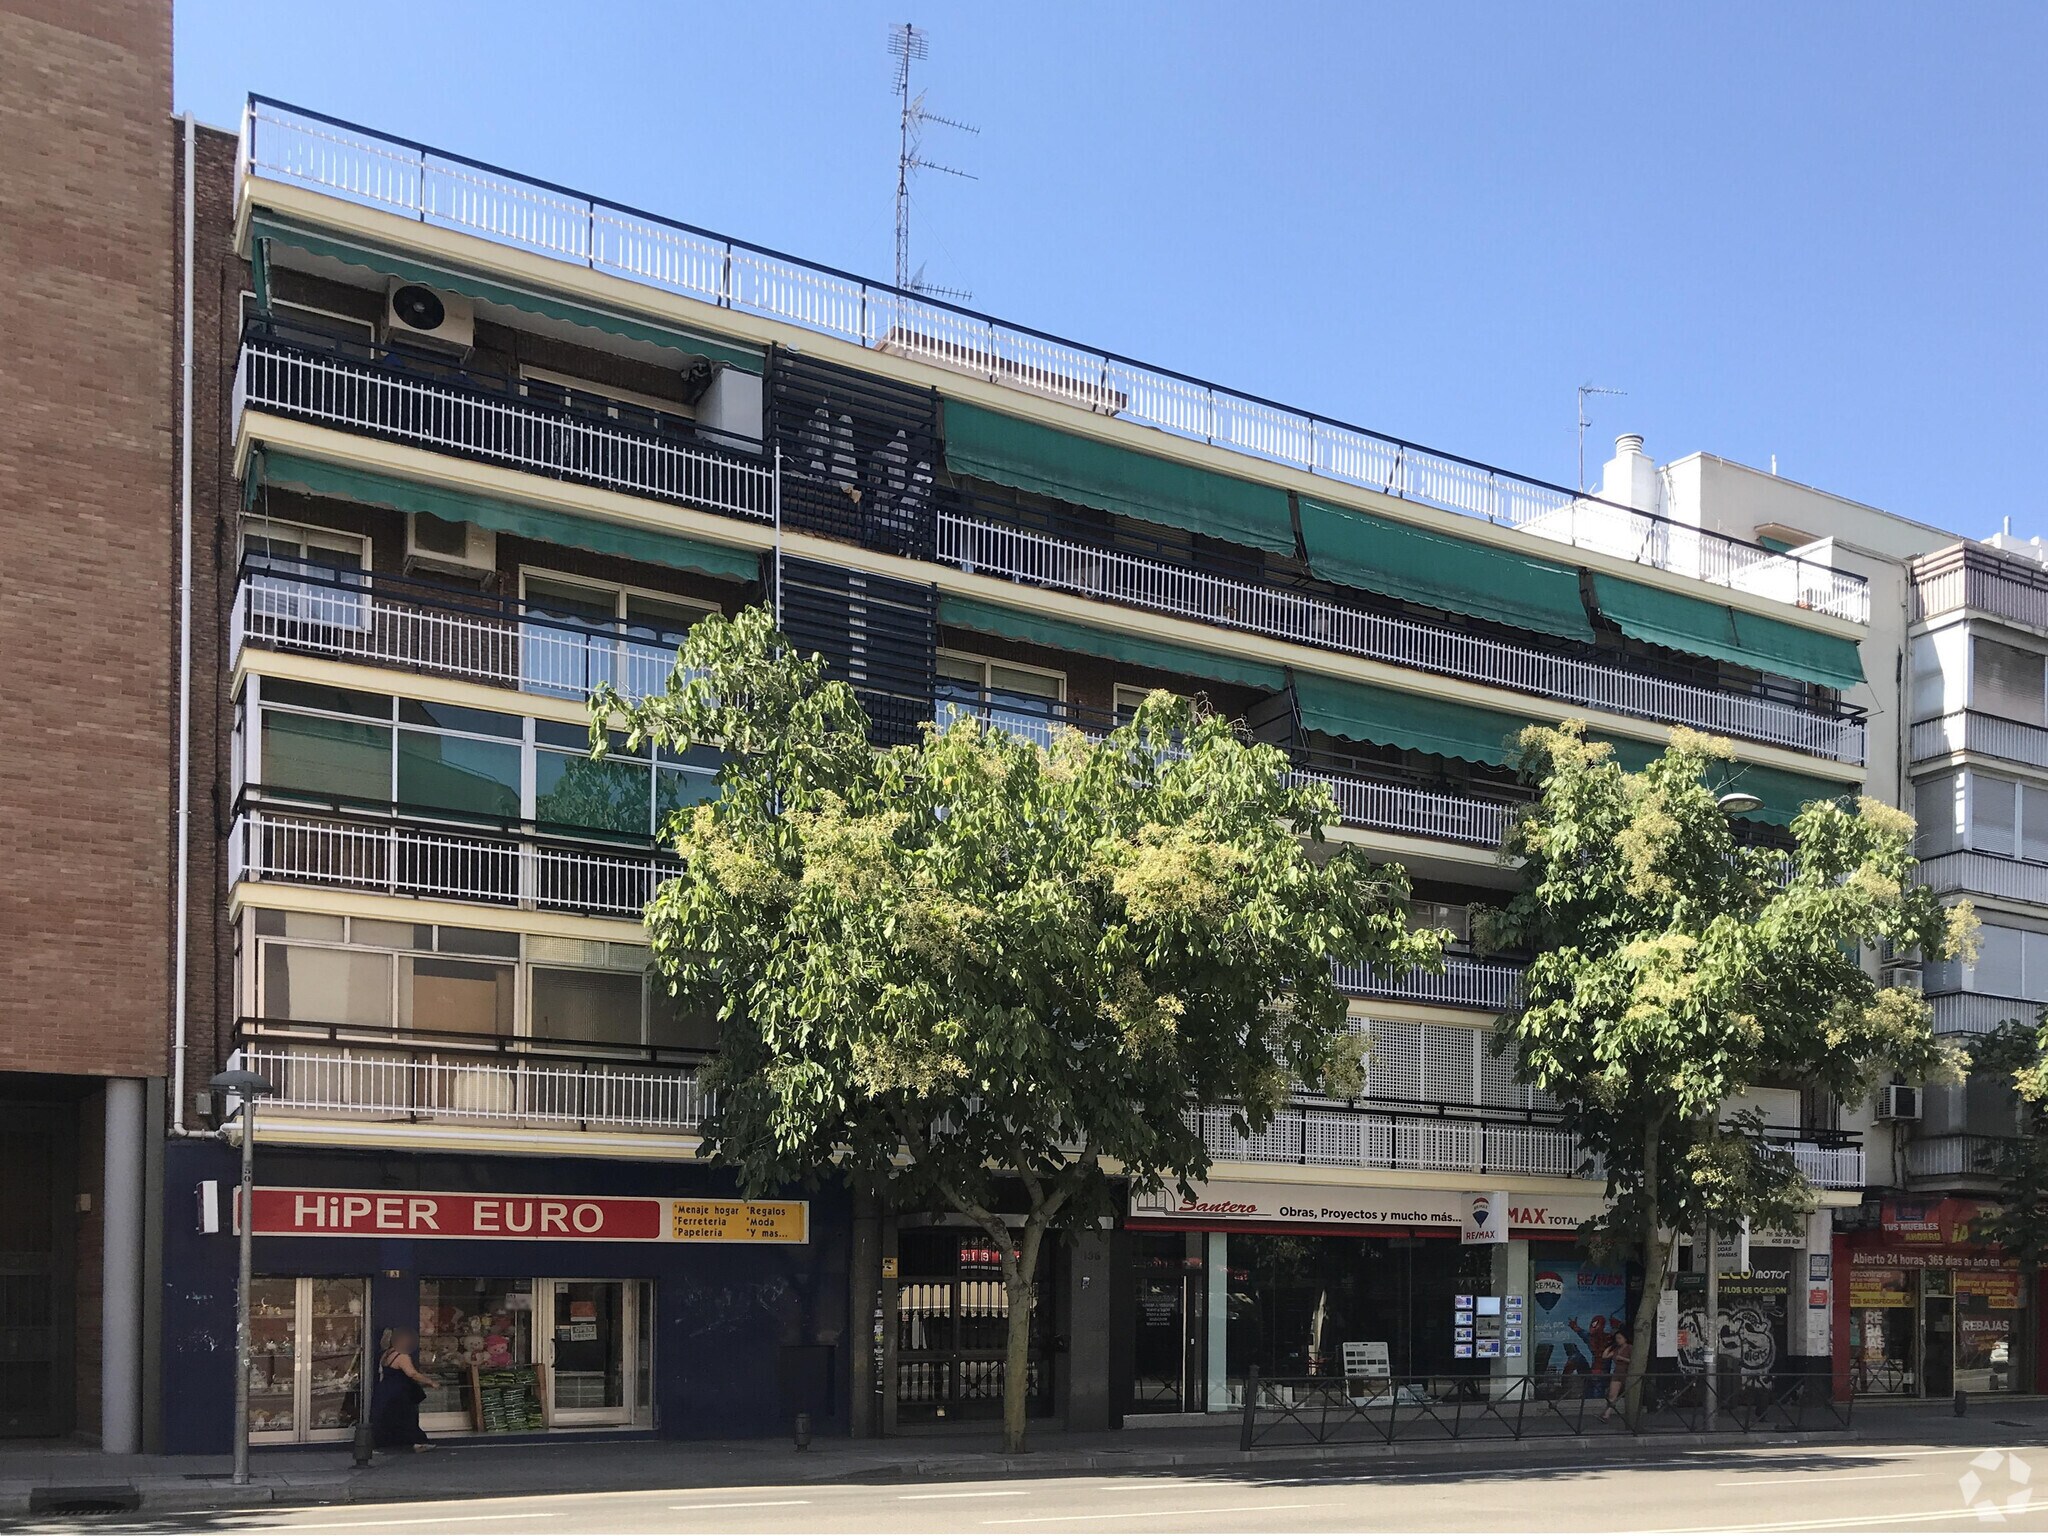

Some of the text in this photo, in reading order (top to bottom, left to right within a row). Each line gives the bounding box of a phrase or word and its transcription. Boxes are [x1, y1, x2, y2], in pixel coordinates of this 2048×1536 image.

[714, 1206, 739, 1216] hogar
[1178, 1196, 1258, 1213] Santero
[294, 1195, 604, 1233] HiPER EURO
[1279, 1206, 1462, 1222] Obras, Proyectos y mucho más...
[1508, 1207, 1580, 1226] MAX TOTAL
[749, 1217, 775, 1227] Moda
[1883, 1222, 1939, 1231] TUS MUEBLES
[1466, 1230, 1496, 1240] RE/MAX
[1852, 1253, 1885, 1265] Abierto
[1887, 1254, 1898, 1265] 24
[1899, 1254, 1927, 1267] horas,
[1928, 1255, 1943, 1265] 365
[1990, 1258, 2000, 1267] en
[1577, 1272, 1623, 1287] RE/MAX
[1742, 1286, 1753, 1295] DE
[1961, 1320, 2010, 1332] REBAJAS
